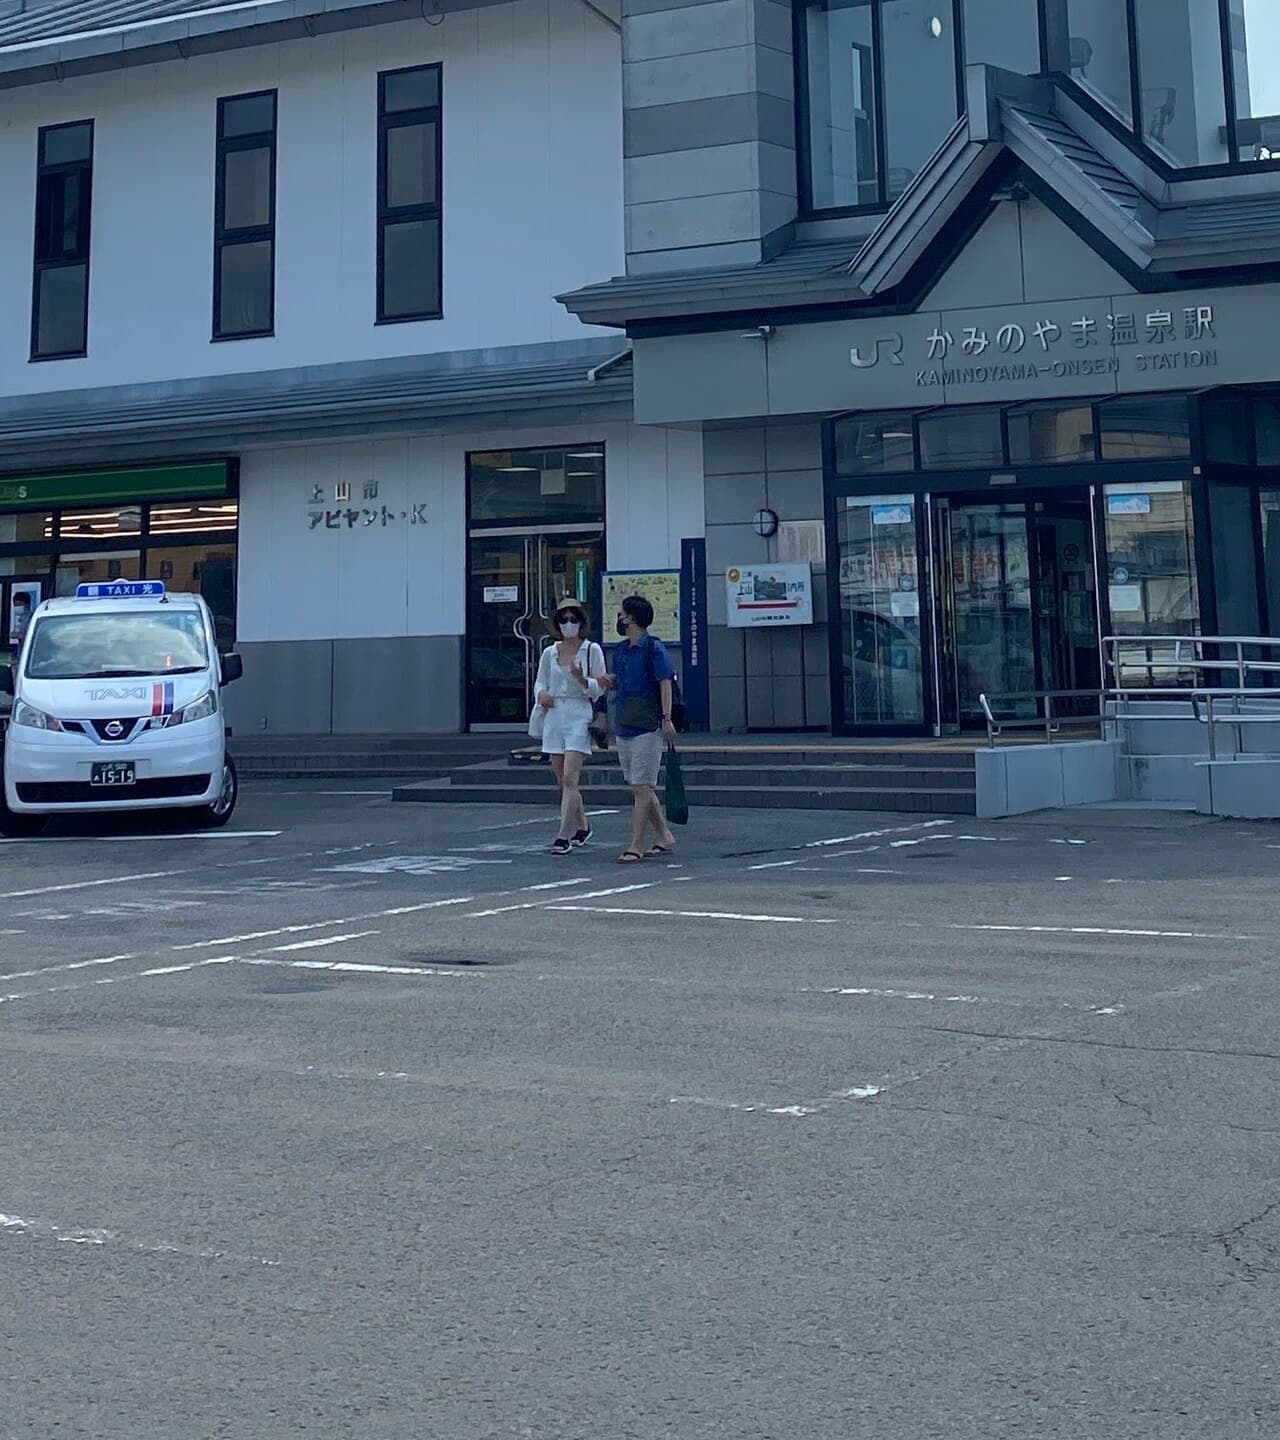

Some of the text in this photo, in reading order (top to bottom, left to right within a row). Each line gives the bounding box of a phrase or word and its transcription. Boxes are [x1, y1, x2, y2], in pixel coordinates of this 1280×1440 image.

[849, 305, 1215, 368] JR かみのやま温泉駅
[914, 348, 1219, 388] KAMINOYAMA-ONSEN STATION
[307, 478, 379, 505] 上山市
[106, 585, 136, 595] TAXI
[83, 687, 148, 702] TAXI
[102, 770, 134, 784] 15-19
